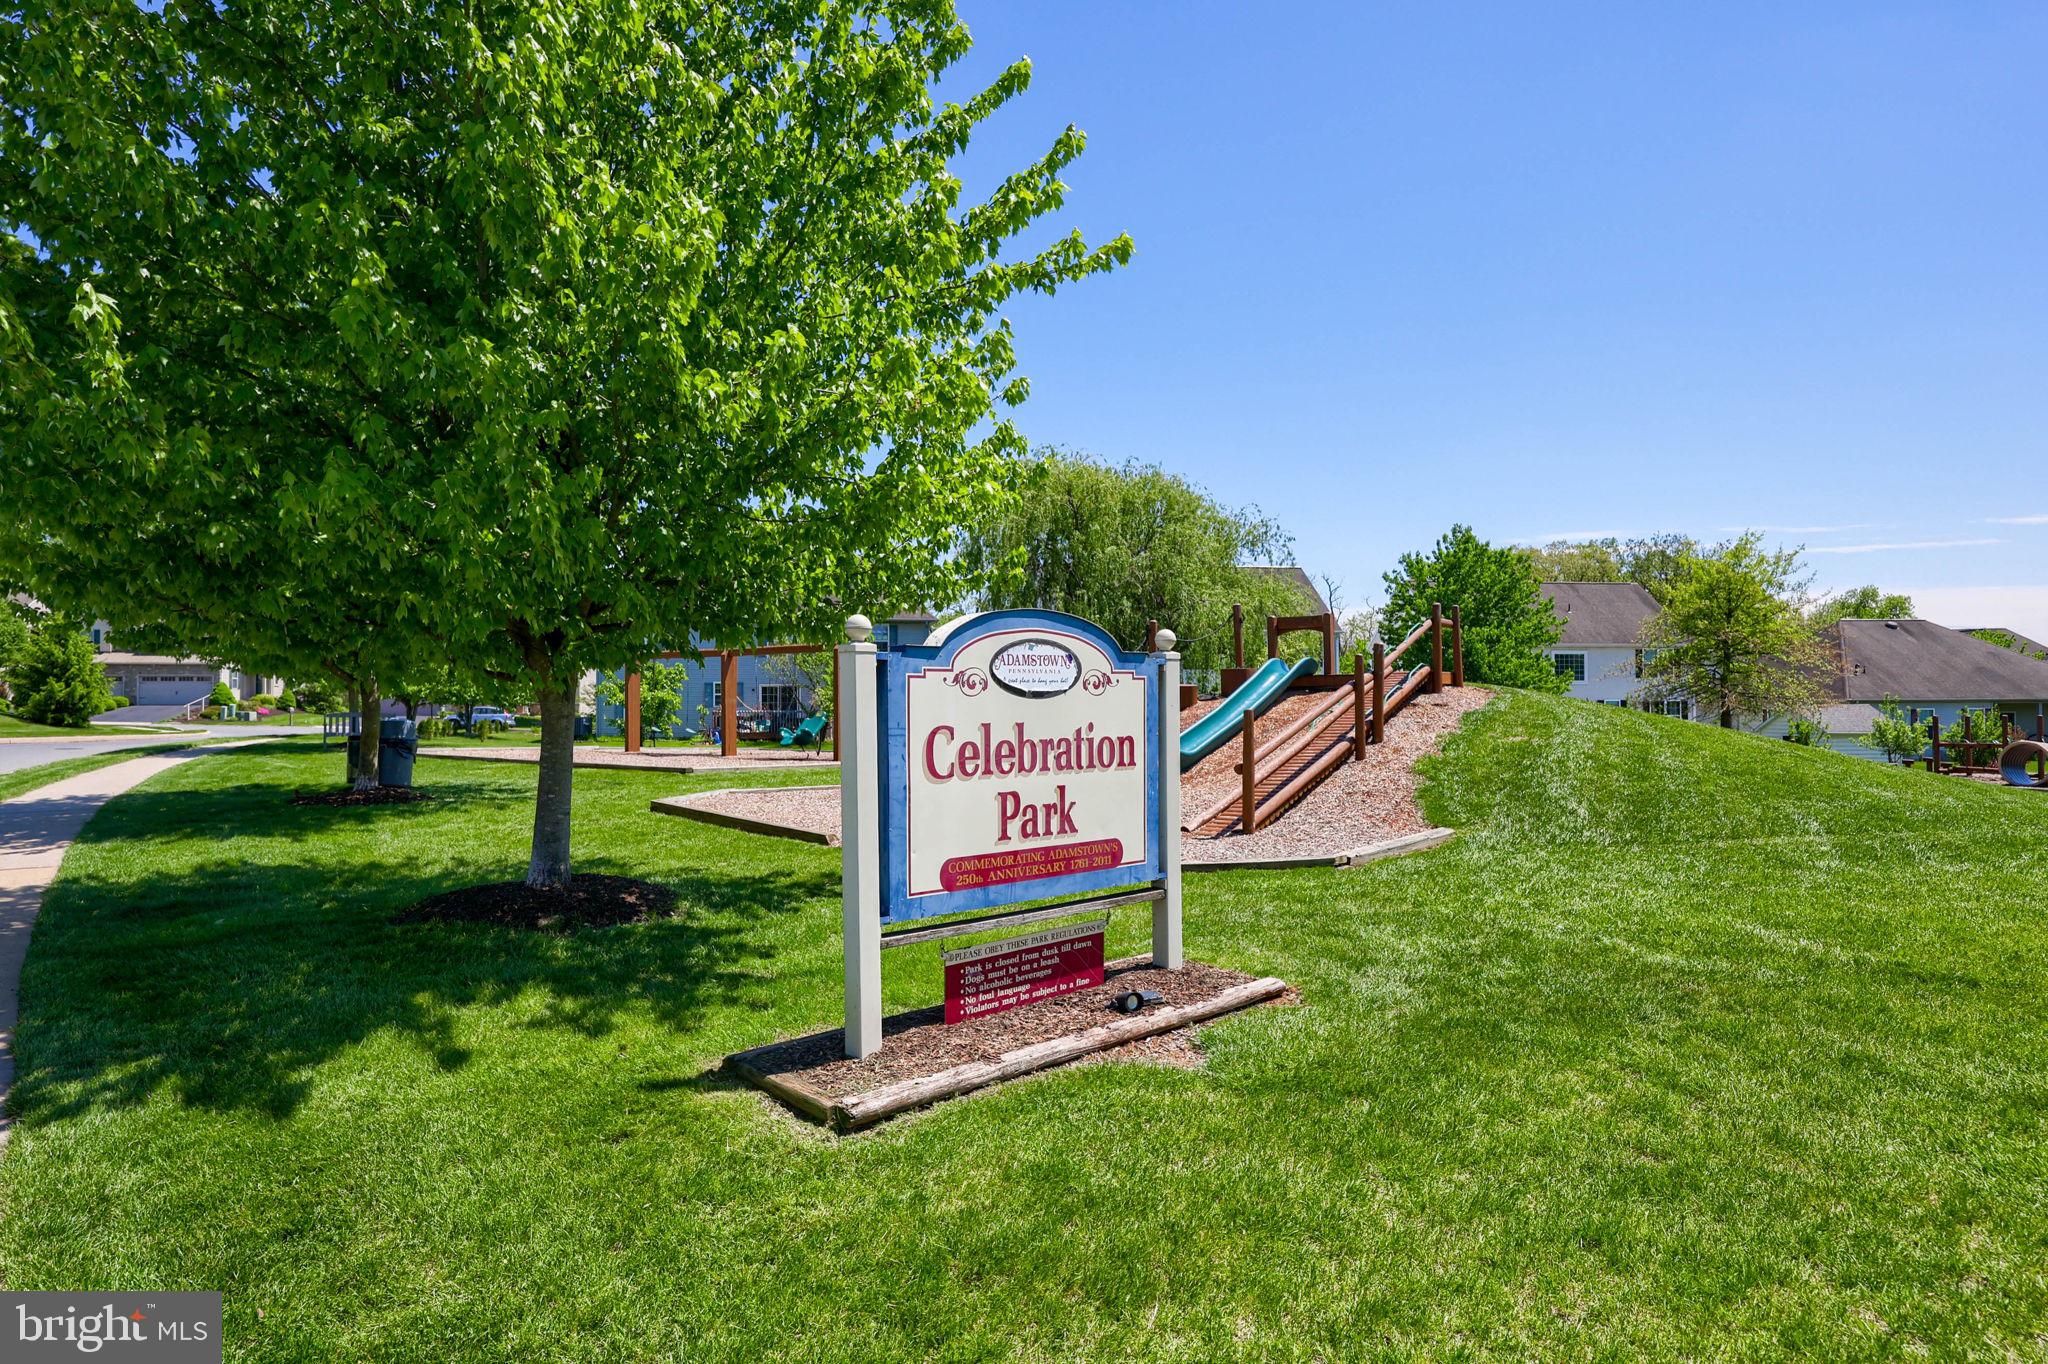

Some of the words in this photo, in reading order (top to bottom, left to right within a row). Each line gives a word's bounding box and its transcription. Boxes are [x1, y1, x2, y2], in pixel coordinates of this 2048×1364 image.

[995, 653, 1070, 670] ADAMSTOWN
[923, 722, 1137, 782] Celebration
[995, 785, 1079, 844] Park
[948, 852, 1045, 873] COMMEMORATING
[1048, 842, 1118, 861] ADAMSTOWN'S
[956, 874, 984, 886] 250th
[988, 861, 1066, 882] ANNIVERSARY
[1071, 855, 1112, 870] 1761-2011
[954, 948, 983, 961] PLEASE
[985, 944, 1005, 955] OBEY
[1006, 938, 1029, 950] THESE
[1031, 934, 1050, 945] PARK
[1050, 924, 1096, 940] REGULATIONS
[965, 963, 983, 974] Park
[985, 961, 993, 970] is
[995, 954, 1020, 967] closed
[1022, 951, 1040, 961] from
[1041, 946, 1059, 957] dusk
[1061, 942, 1072, 952] till
[1073, 940, 1092, 950] dawn
[965, 974, 985, 985] Dogs
[988, 969, 1007, 979] must
[1008, 966, 1019, 974] be
[1021, 963, 1031, 971] on
[1040, 956, 1060, 967] leash
[965, 986, 977, 995] No
[979, 976, 1013, 992] alcoholic
[1015, 968, 1052, 983] beverages
[965, 996, 977, 1005] No
[979, 990, 995, 1002] foul
[997, 983, 1031, 997] language
[965, 1000, 1000, 1015] Violators
[1002, 996, 1018, 1006] may
[1020, 992, 1030, 1001] be
[1032, 985, 1058, 998] subject
[1060, 983, 1067, 991] to
[1075, 977, 1090, 987] fine
